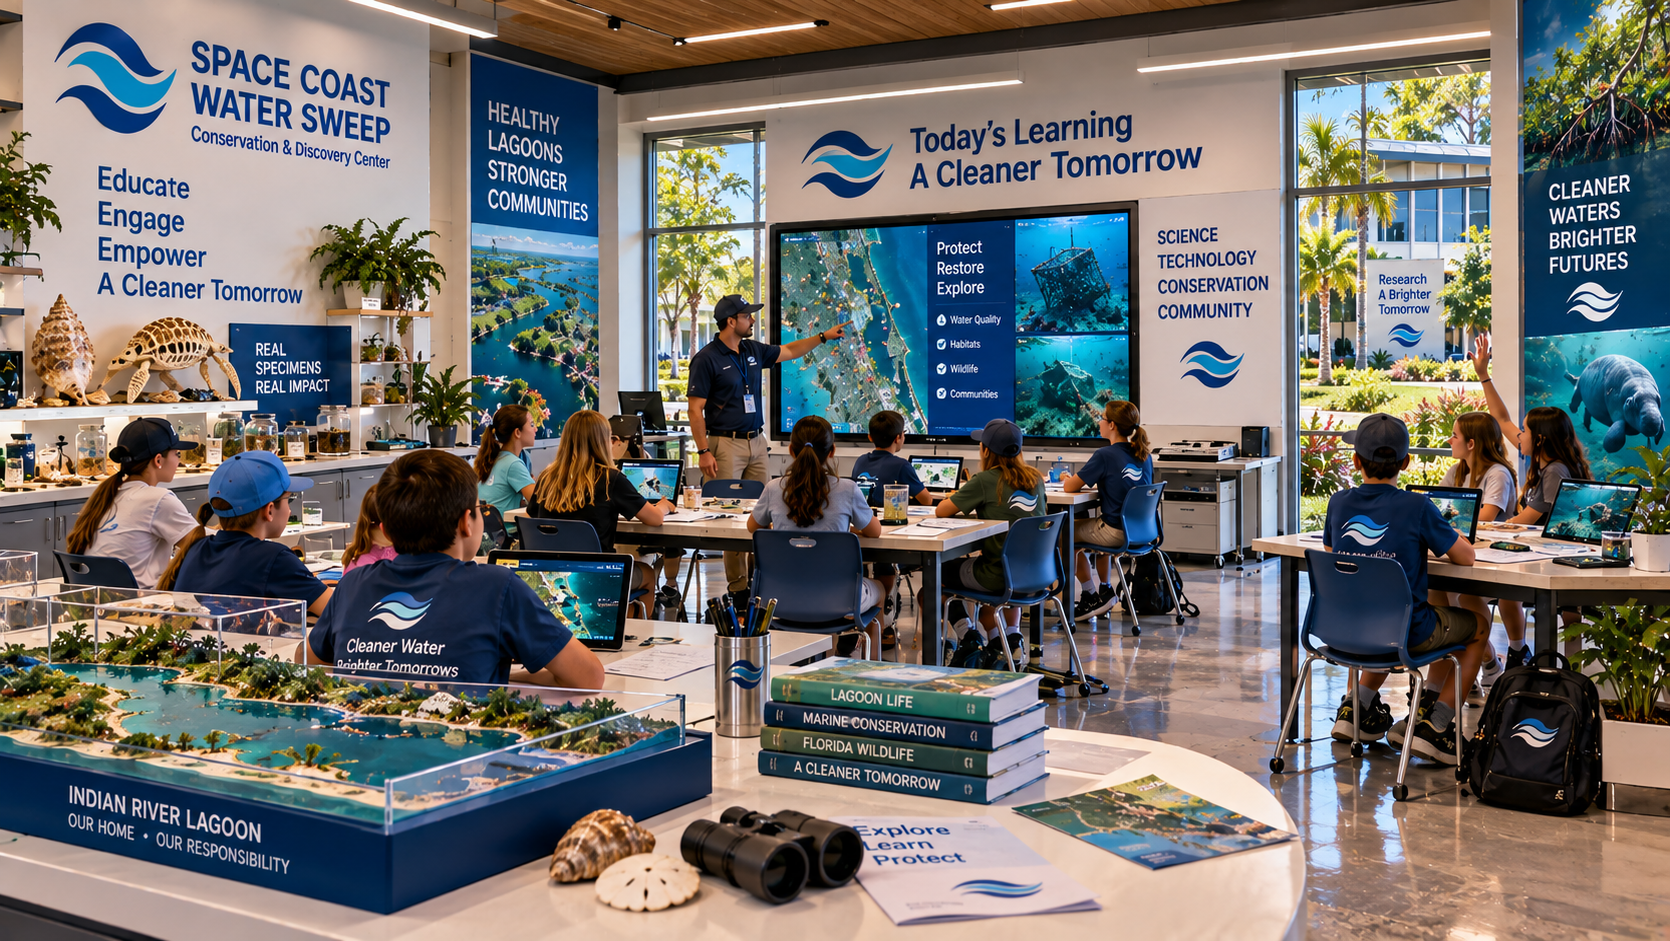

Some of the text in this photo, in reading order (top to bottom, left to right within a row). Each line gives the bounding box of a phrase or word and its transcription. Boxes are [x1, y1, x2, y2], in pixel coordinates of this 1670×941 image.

[191, 41, 390, 108] SPACE COAST
[191, 82, 390, 143] WATER SWEEP
[488, 100, 559, 135] HEALTHY
[910, 110, 1132, 155] Today's Learning
[192, 126, 390, 168] Conservation & Discovery Center
[488, 130, 562, 164] LAGOONS
[488, 159, 567, 192] STRONGER
[910, 147, 1202, 189] A Cleaner Tomorrow
[99, 166, 189, 200] Educate
[1549, 174, 1630, 201] CLEANER
[488, 188, 588, 221] COMMUNITIES
[1549, 201, 1621, 225] WATERS
[99, 201, 184, 236] Engage
[1158, 227, 1218, 244] SCIENCE
[1550, 226, 1636, 249] BRIGHTER
[99, 236, 206, 269] Empower
[938, 241, 982, 255] Protect
[938, 262, 984, 275] Restore
[1158, 250, 1256, 269] TECHNOLOGY
[1550, 252, 1628, 274] FUTURES
[98, 273, 302, 303] A Cleaner Tomorrow
[1158, 276, 1268, 294] CONSERVATION
[1379, 273, 1426, 284] Research
[938, 281, 984, 298] Explore
[1379, 289, 1431, 302] A Brighter
[1158, 303, 1252, 319] COMMUNITY
[1379, 304, 1430, 314] Tomorrow
[950, 315, 1001, 325] Water Quality
[256, 343, 286, 356] REAL
[950, 340, 981, 348] Habitats
[256, 361, 321, 375] SPECIMENS
[950, 364, 978, 373] Wildlife
[256, 379, 330, 394] REAL IMPACT
[950, 389, 998, 398] Communities
[347, 638, 445, 655] Cleaner Water
[384, 660, 458, 677] Tomorrows
[831, 687, 913, 708] LAGOON LIFE
[804, 712, 945, 738] MARINE CONSERVATION
[804, 737, 914, 761] FLORIDA WILDLIFE
[794, 761, 940, 791] A CLEANER TOMORROW
[69, 785, 260, 843] INDIAN RIVER LAGOON
[853, 825, 950, 838] Explore
[68, 813, 289, 874] OUR HOME OUR RESPONSIBILITY
[862, 840, 933, 851] Learn
[873, 853, 966, 865] Protect
